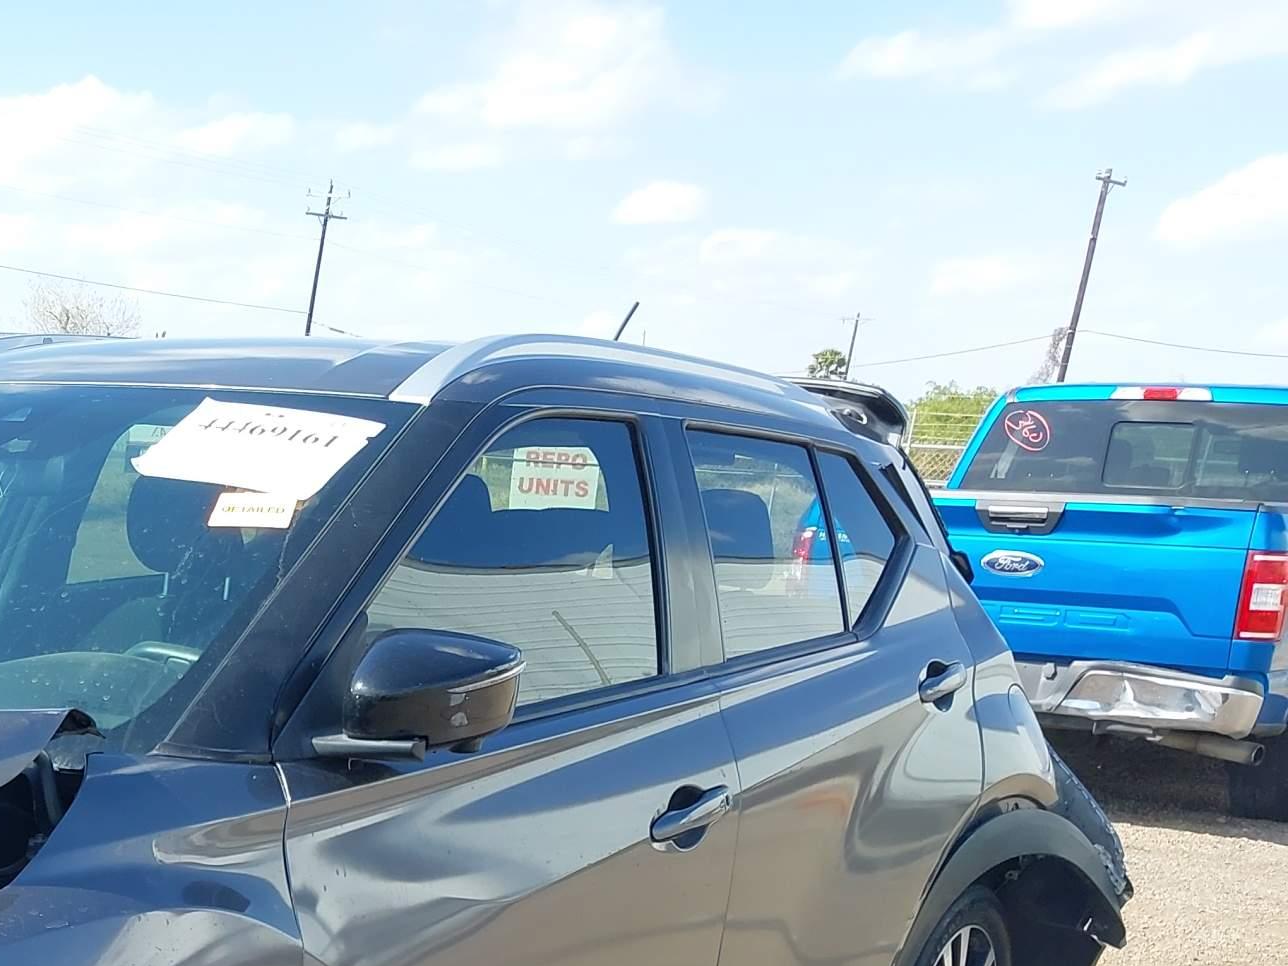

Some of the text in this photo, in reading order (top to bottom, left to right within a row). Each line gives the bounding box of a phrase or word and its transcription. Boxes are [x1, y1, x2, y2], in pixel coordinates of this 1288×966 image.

[526, 451, 588, 469] REPO
[519, 477, 589, 497] UNITS
[994, 555, 1030, 571] Ford
